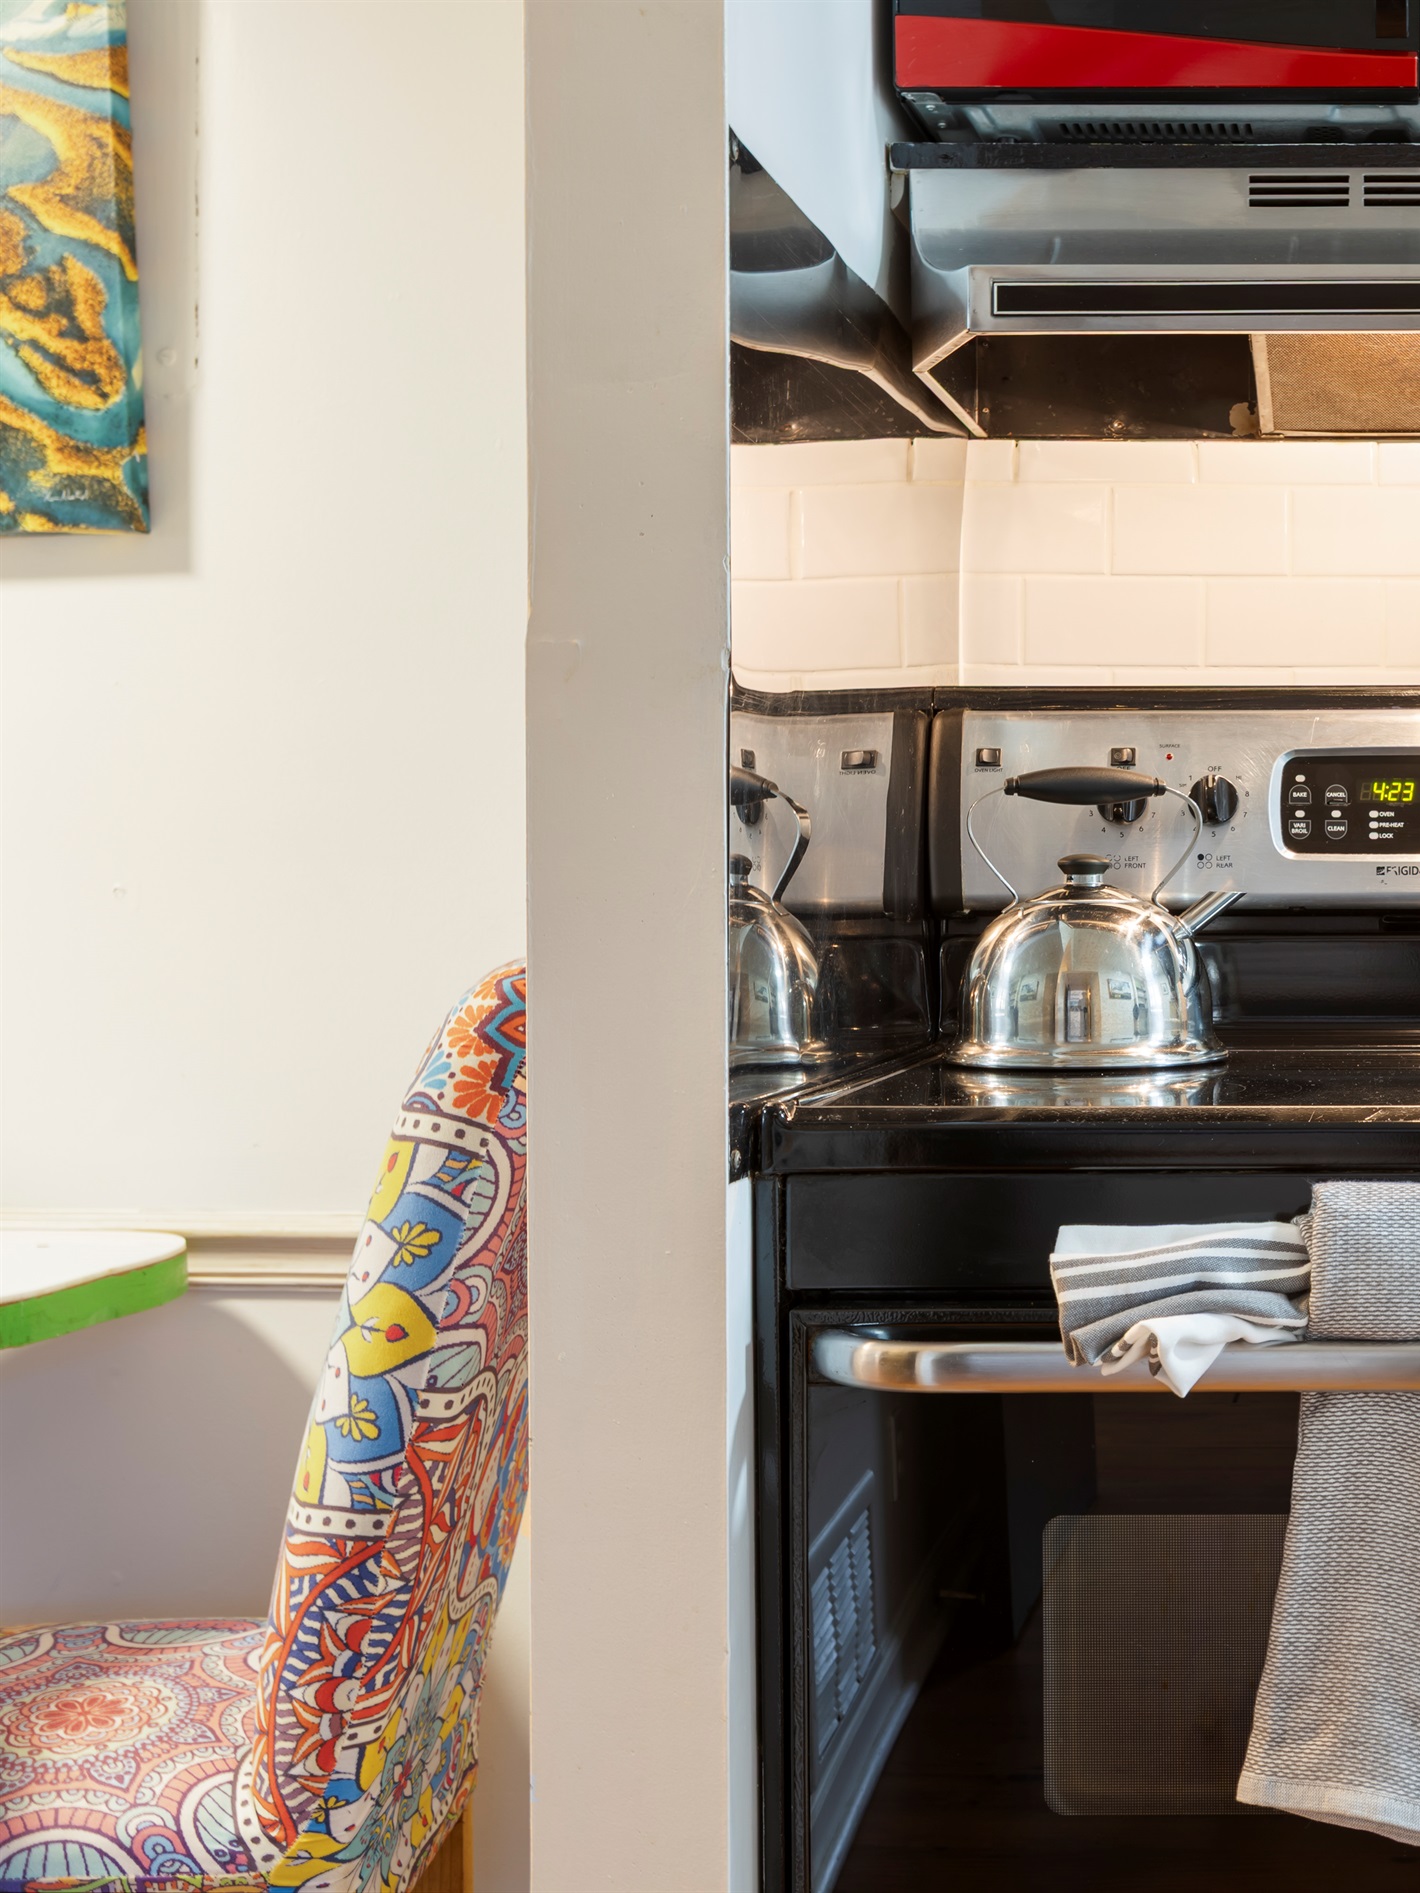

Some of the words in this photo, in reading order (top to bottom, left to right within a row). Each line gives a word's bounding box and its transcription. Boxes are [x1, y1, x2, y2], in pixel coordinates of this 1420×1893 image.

[1244, 790, 1250, 798] 8
[1373, 782, 1415, 801] 4:23
[1119, 831, 1125, 839] 5
